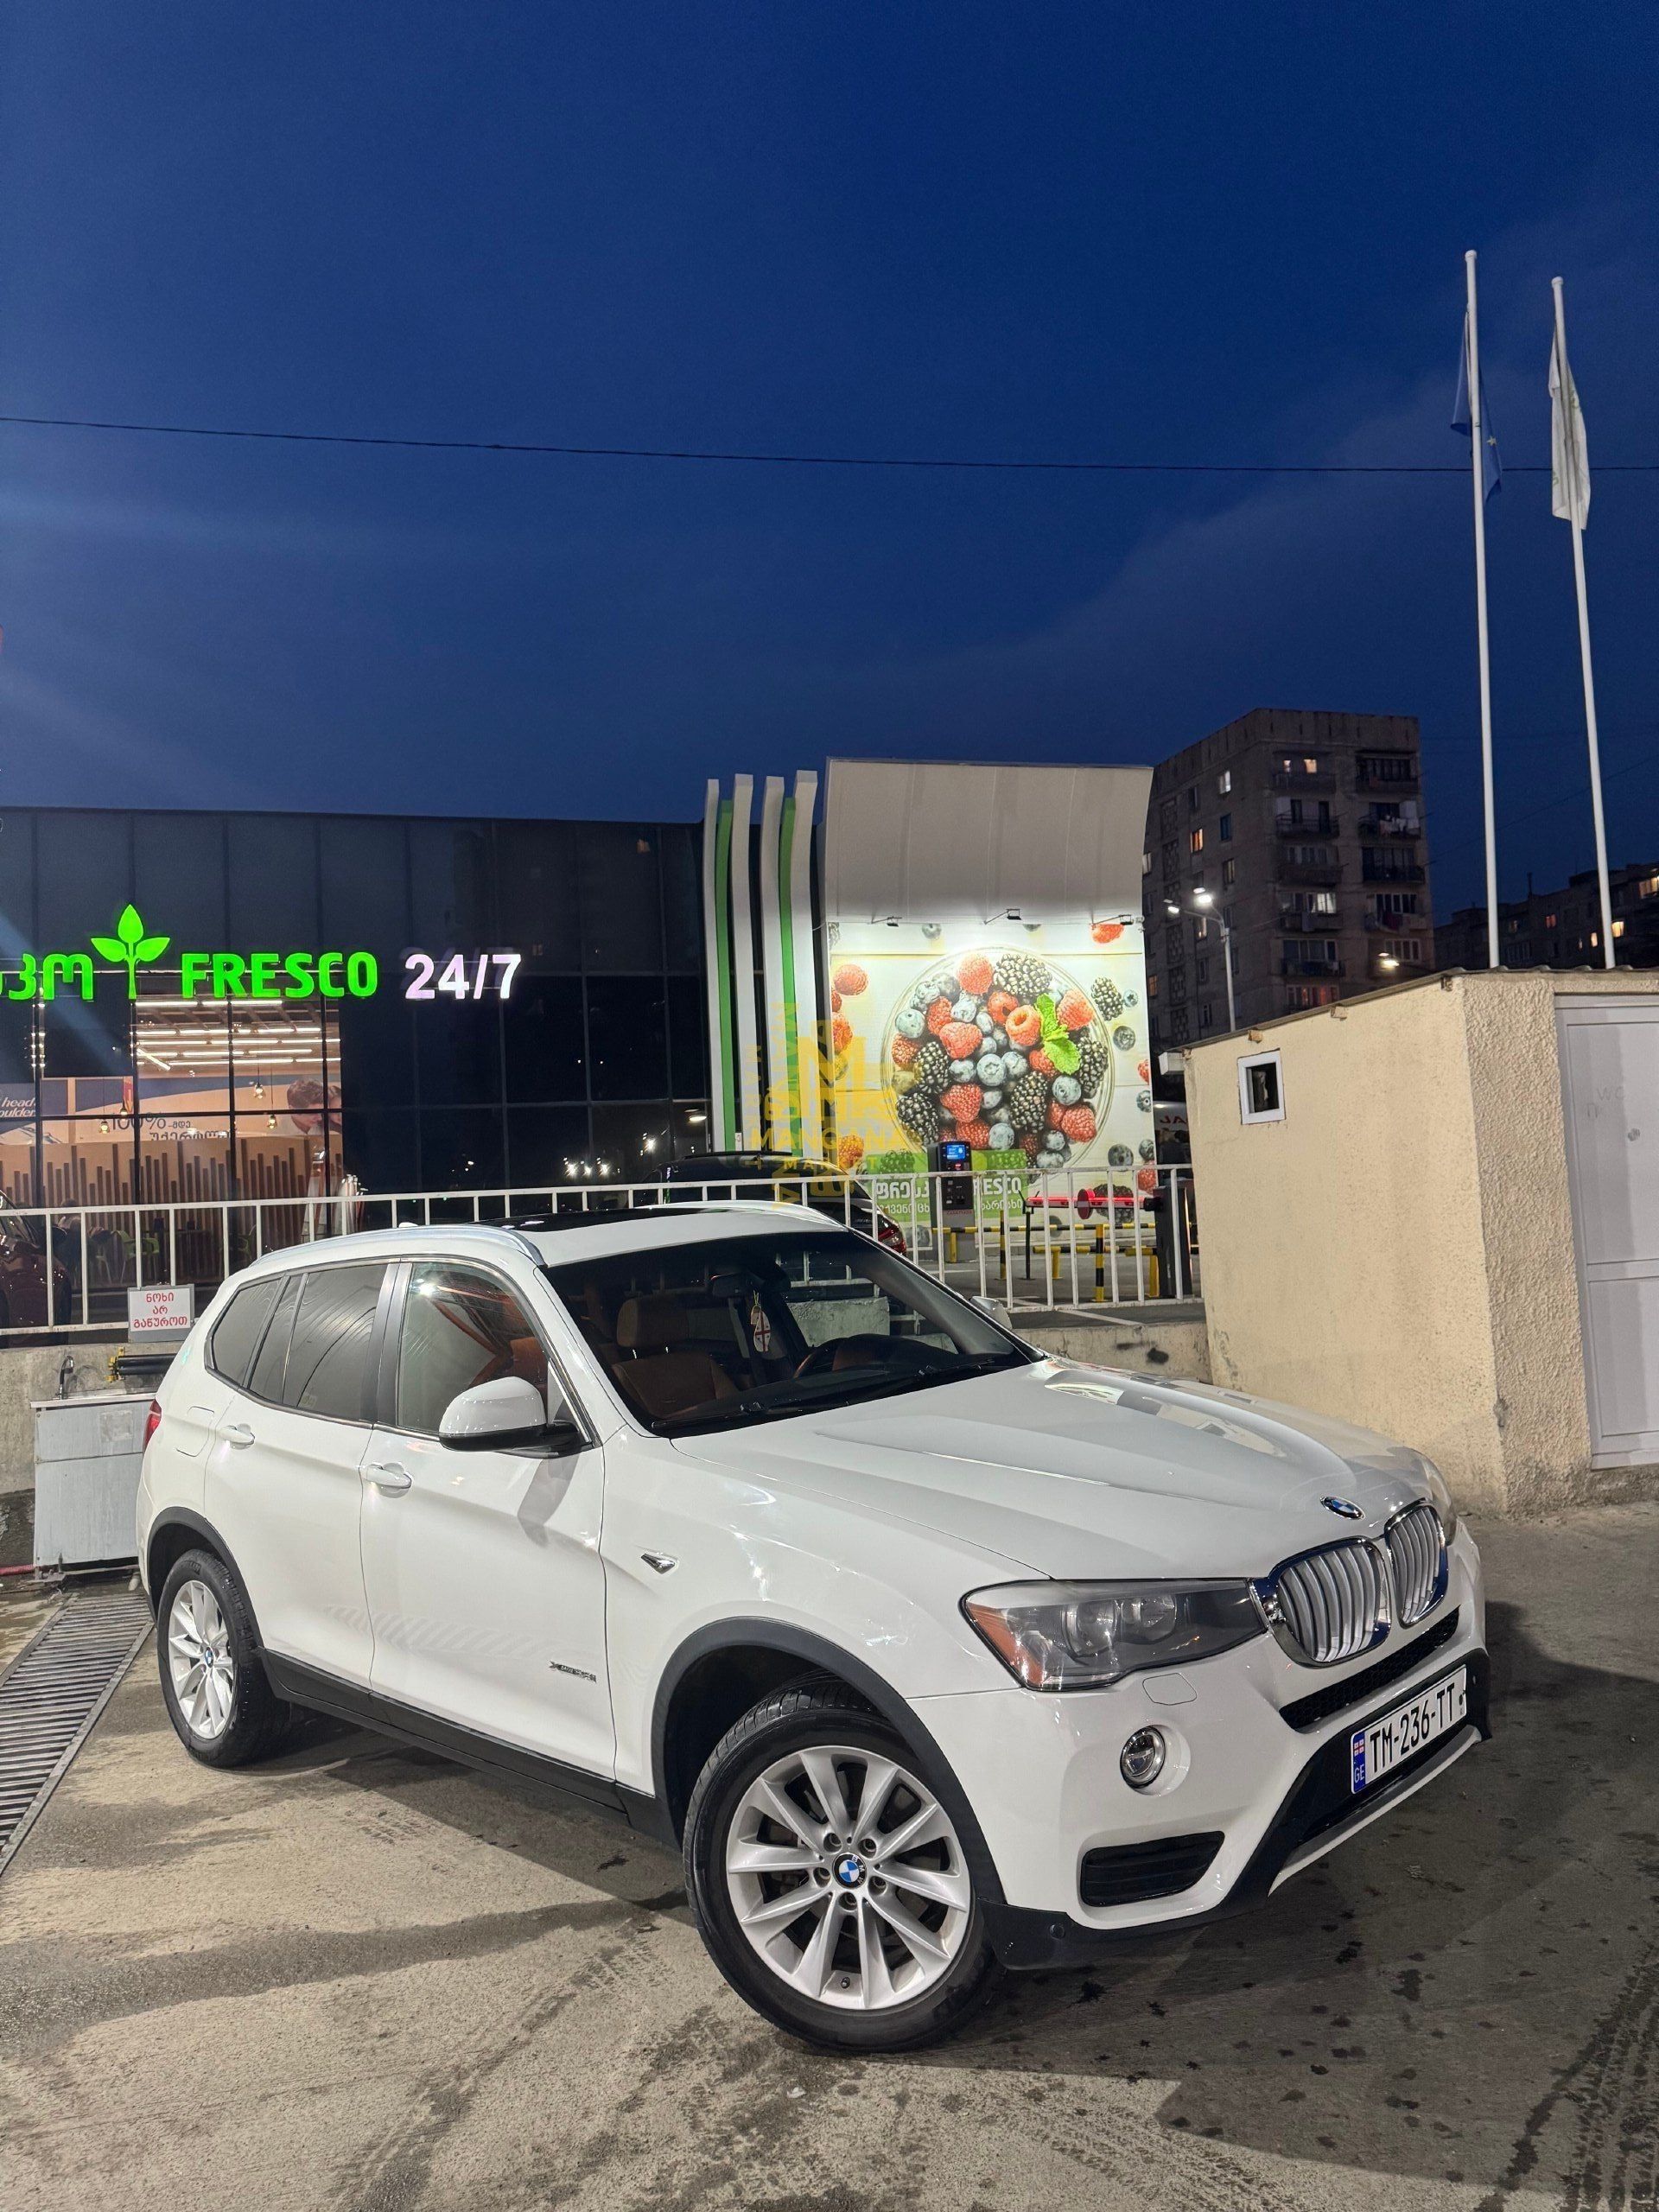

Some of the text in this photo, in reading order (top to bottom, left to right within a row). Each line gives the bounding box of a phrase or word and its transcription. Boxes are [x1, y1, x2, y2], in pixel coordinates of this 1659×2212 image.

[0, 954, 93, 1000] კო
[181, 951, 521, 1000] FRESCO 24/7
[146, 1292, 175, 1303] ნოხი
[153, 1306, 168, 1315] არ
[1370, 1682, 1455, 1772] TM-236-TT
[1354, 1764, 1365, 1783] GE
